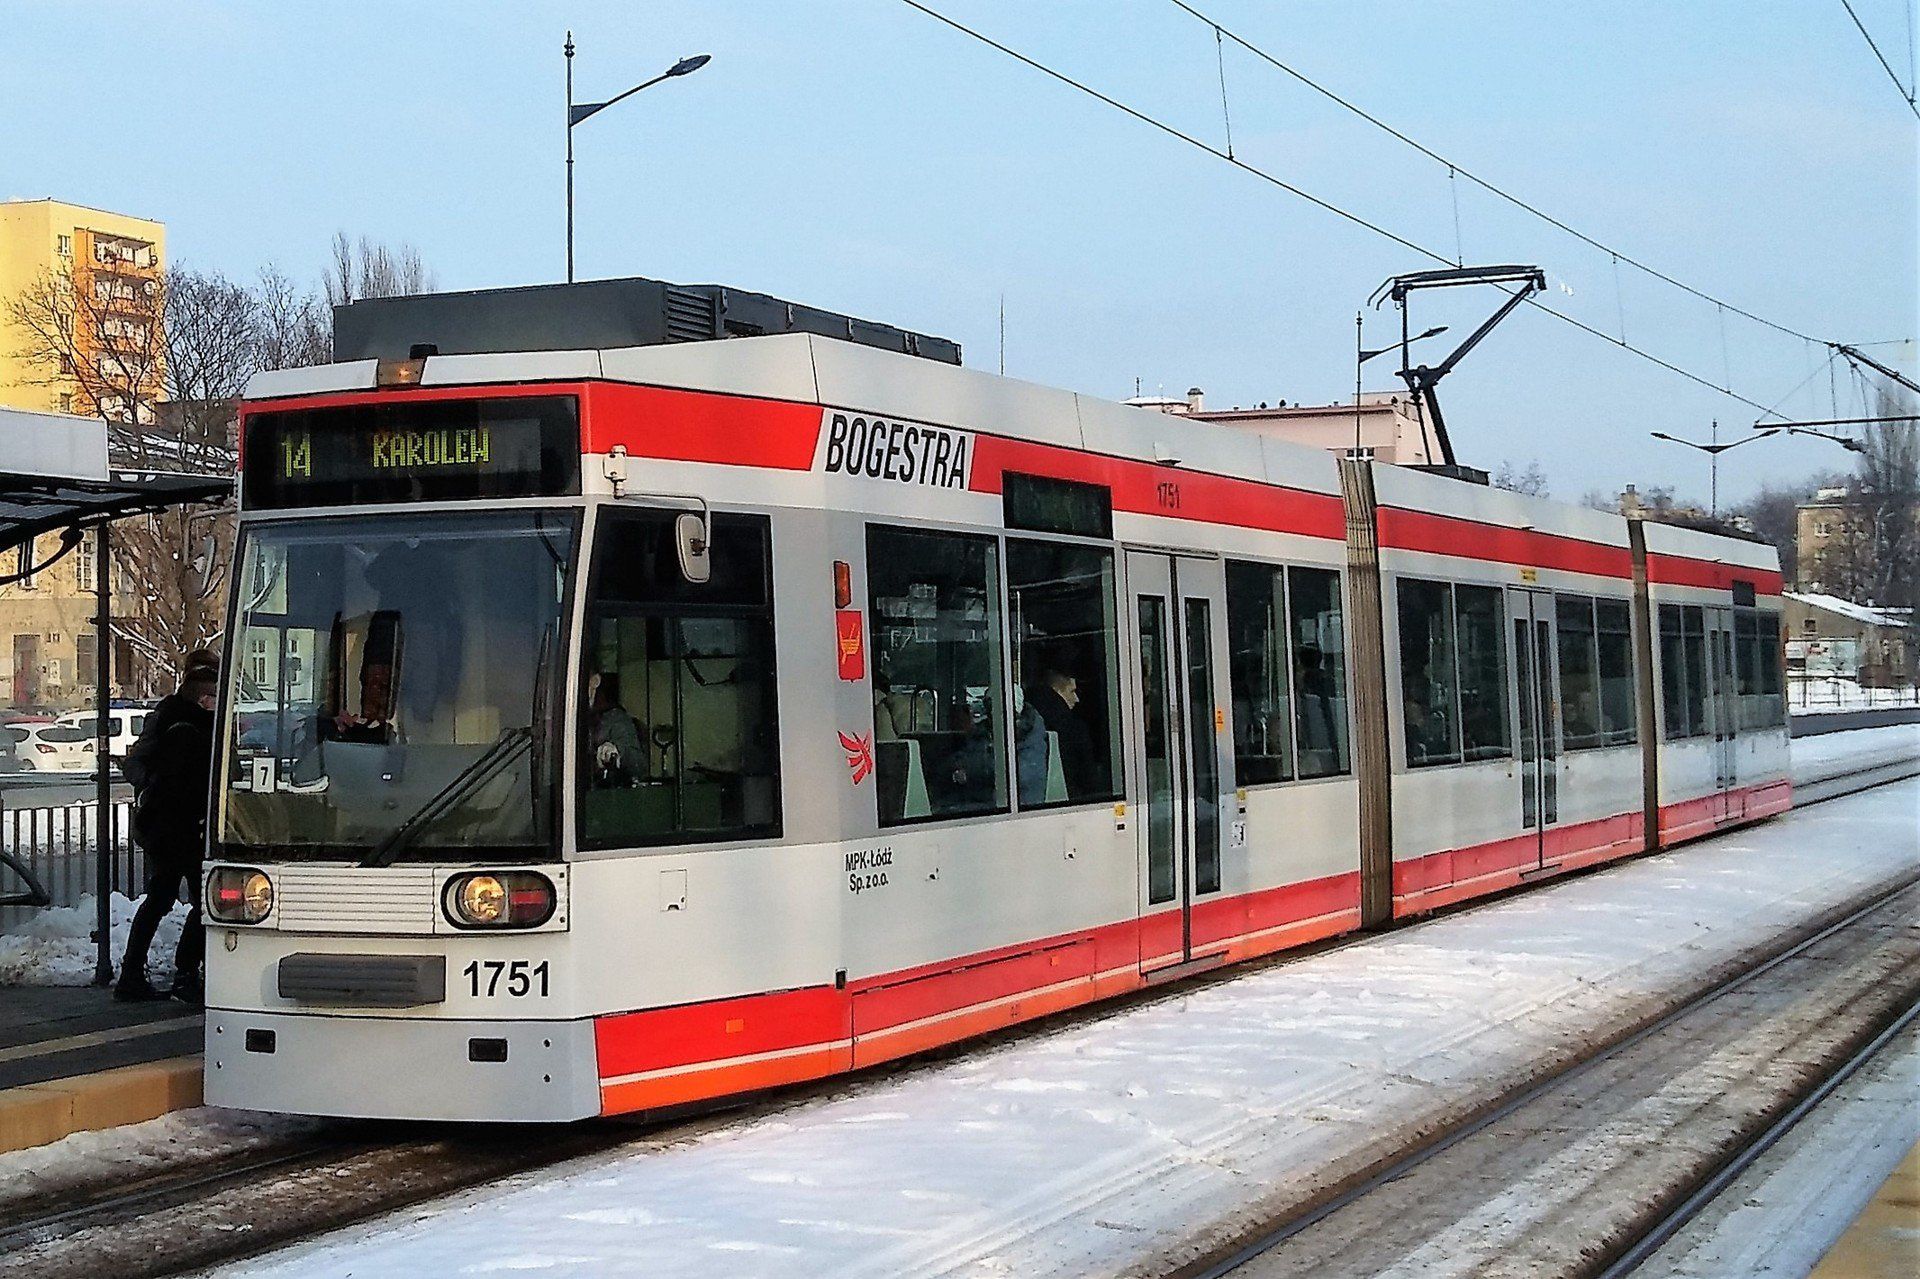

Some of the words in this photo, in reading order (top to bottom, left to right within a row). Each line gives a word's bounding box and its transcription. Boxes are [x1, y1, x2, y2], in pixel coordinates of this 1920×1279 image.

[281, 434, 311, 478] 14
[373, 429, 489, 467] KAROLEW
[825, 413, 968, 490] BOGESTRA
[1157, 482, 1180, 509] 1751
[260, 766, 269, 786] 7
[462, 960, 549, 998] 1751
